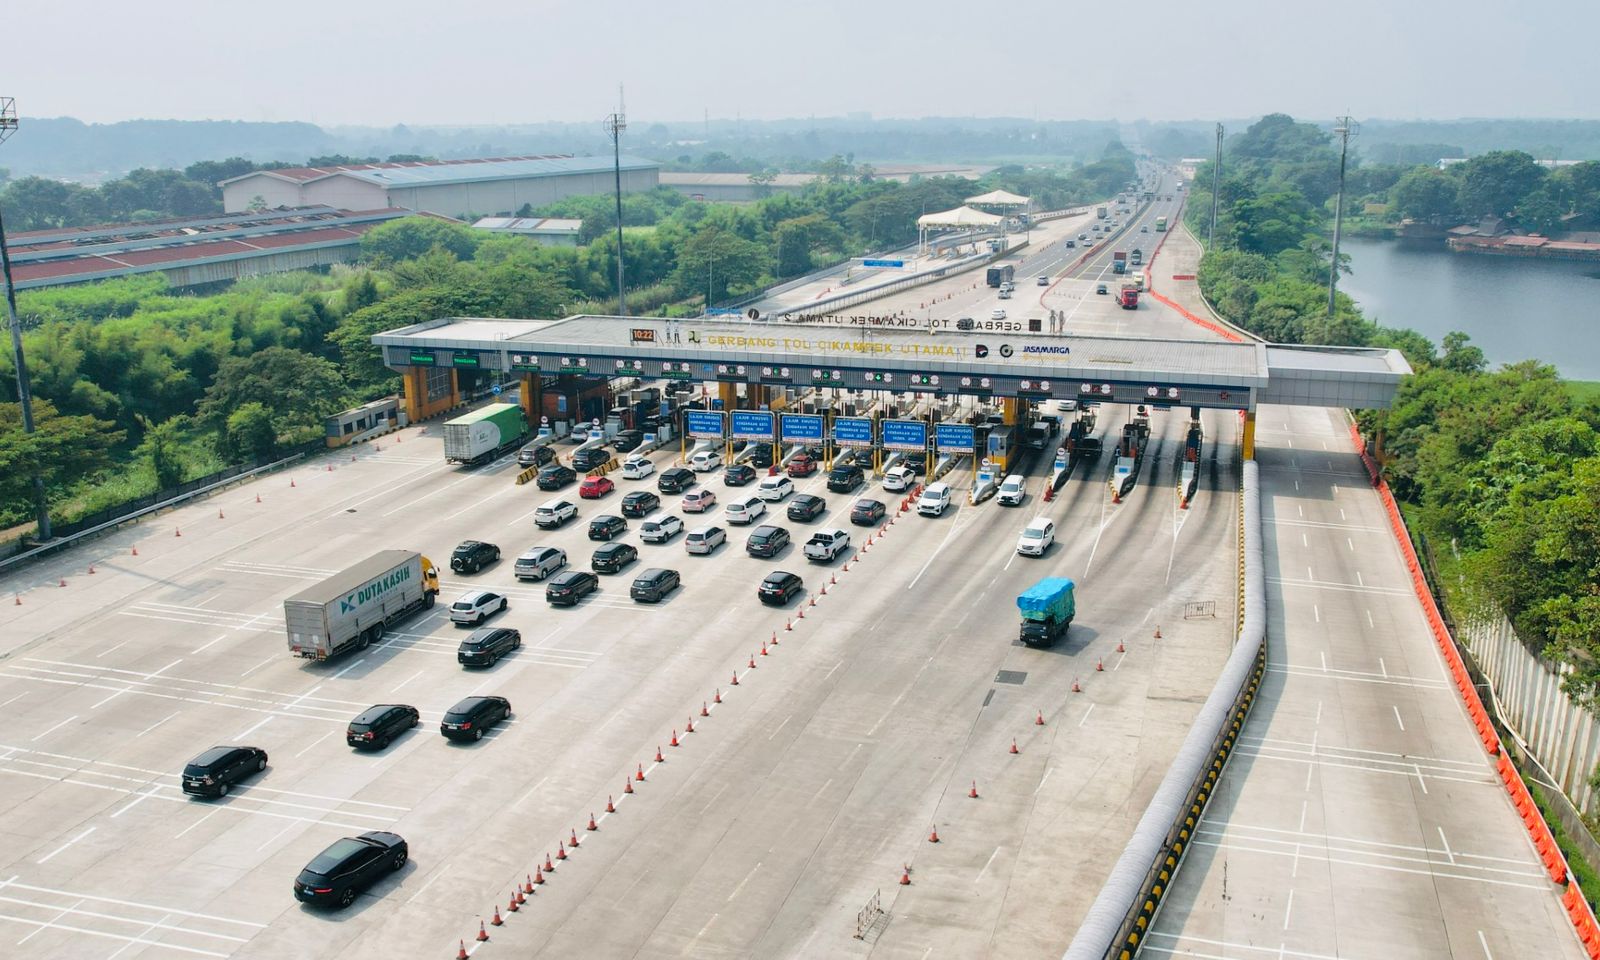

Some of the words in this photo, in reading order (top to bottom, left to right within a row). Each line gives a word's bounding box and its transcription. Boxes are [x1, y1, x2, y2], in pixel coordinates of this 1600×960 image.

[634, 330, 653, 339] 10:22
[708, 335, 776, 348] GERBANG
[783, 338, 811, 350] TOL
[818, 340, 892, 354] CIKAMPEK
[901, 344, 954, 356] UTAMA
